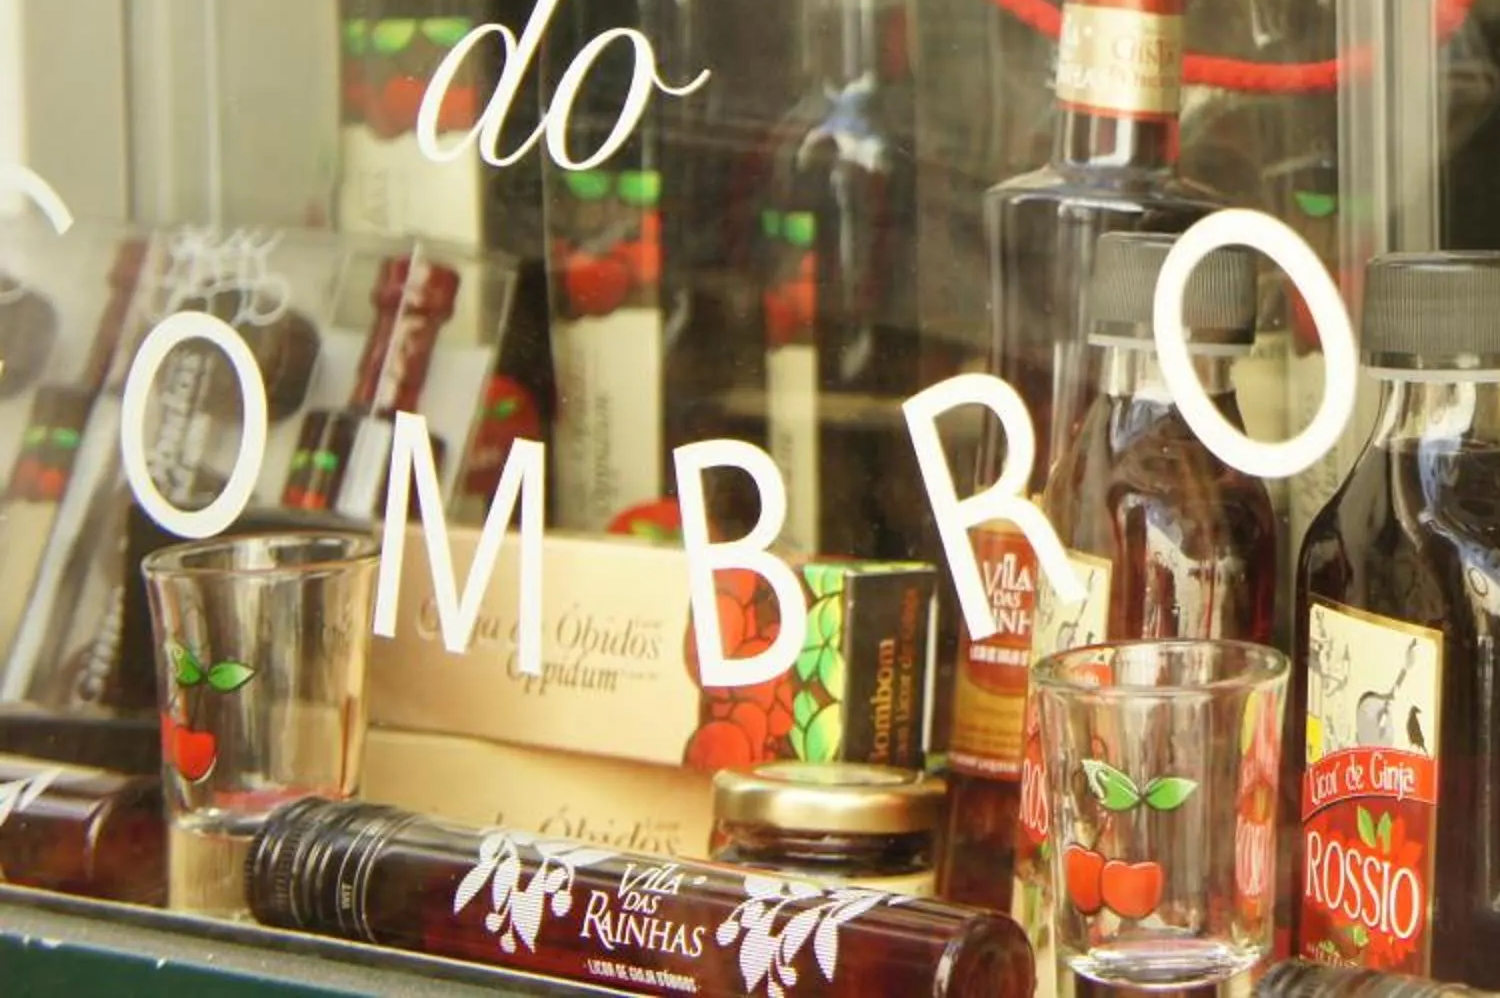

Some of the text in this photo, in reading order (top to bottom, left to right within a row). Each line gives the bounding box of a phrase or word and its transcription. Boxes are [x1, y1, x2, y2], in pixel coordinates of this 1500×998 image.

[0, 163, 1357, 690] OMBRO
[1309, 761, 1339, 805] Licor
[1345, 753, 1365, 792] de
[1369, 752, 1416, 802] Ginja
[621, 891, 662, 914] DAS
[1304, 830, 1421, 940] ROSSIO
[579, 889, 706, 958] RAINHAS
